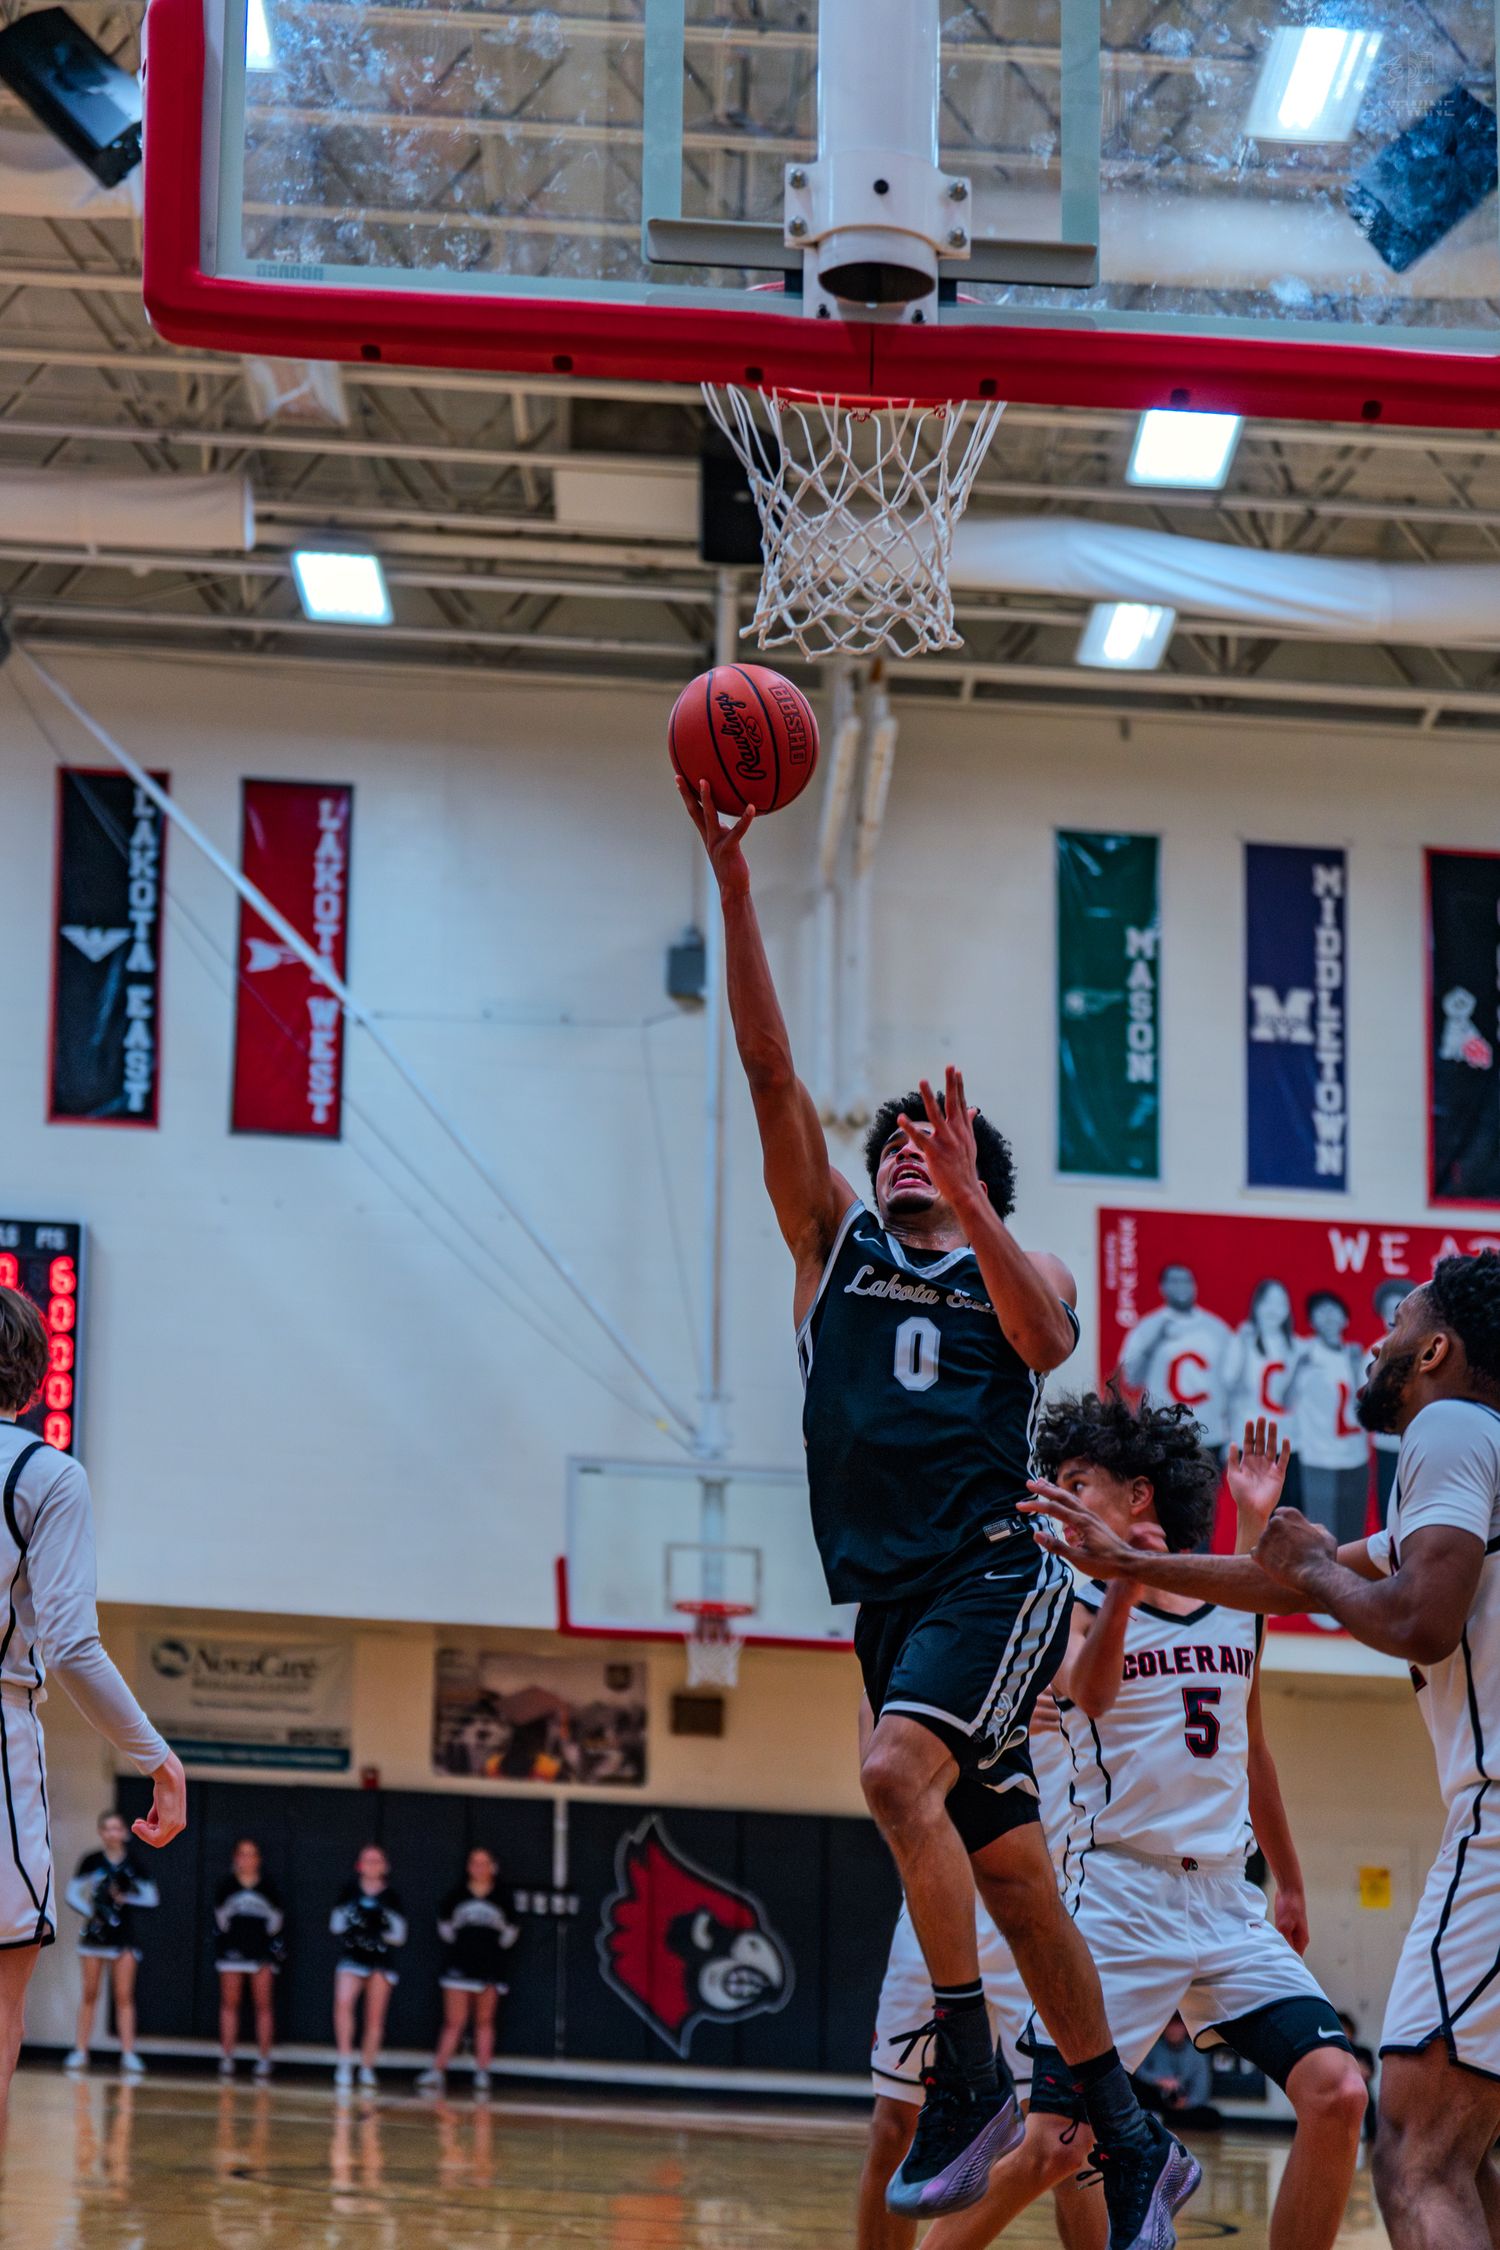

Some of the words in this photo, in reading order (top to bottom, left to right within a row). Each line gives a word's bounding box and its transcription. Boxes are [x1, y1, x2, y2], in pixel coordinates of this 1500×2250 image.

[715, 692, 767, 780] Rawlings
[768, 683, 808, 765] OHSAA
[126, 788, 160, 973] LAKOTA
[1126, 926, 1159, 1084] MASON
[1250, 985, 1314, 1043] M
[1312, 864, 1347, 1176] MIDDLETOWN
[122, 984, 154, 1113] EAST
[306, 998, 341, 1124] WEST
[49, 1255, 77, 1295] 6
[1328, 1228, 1410, 1276] WE
[48, 1294, 76, 1333] 0
[844, 1264, 940, 1305] Lakota
[47, 1333, 74, 1372] 0
[894, 1316, 941, 1392] 0
[1167, 1350, 1210, 1406] C
[45, 1372, 73, 1411] 0
[44, 1411, 71, 1451] 0
[193, 1648, 318, 1680] NovaCare
[1182, 1687, 1221, 1759] 5
